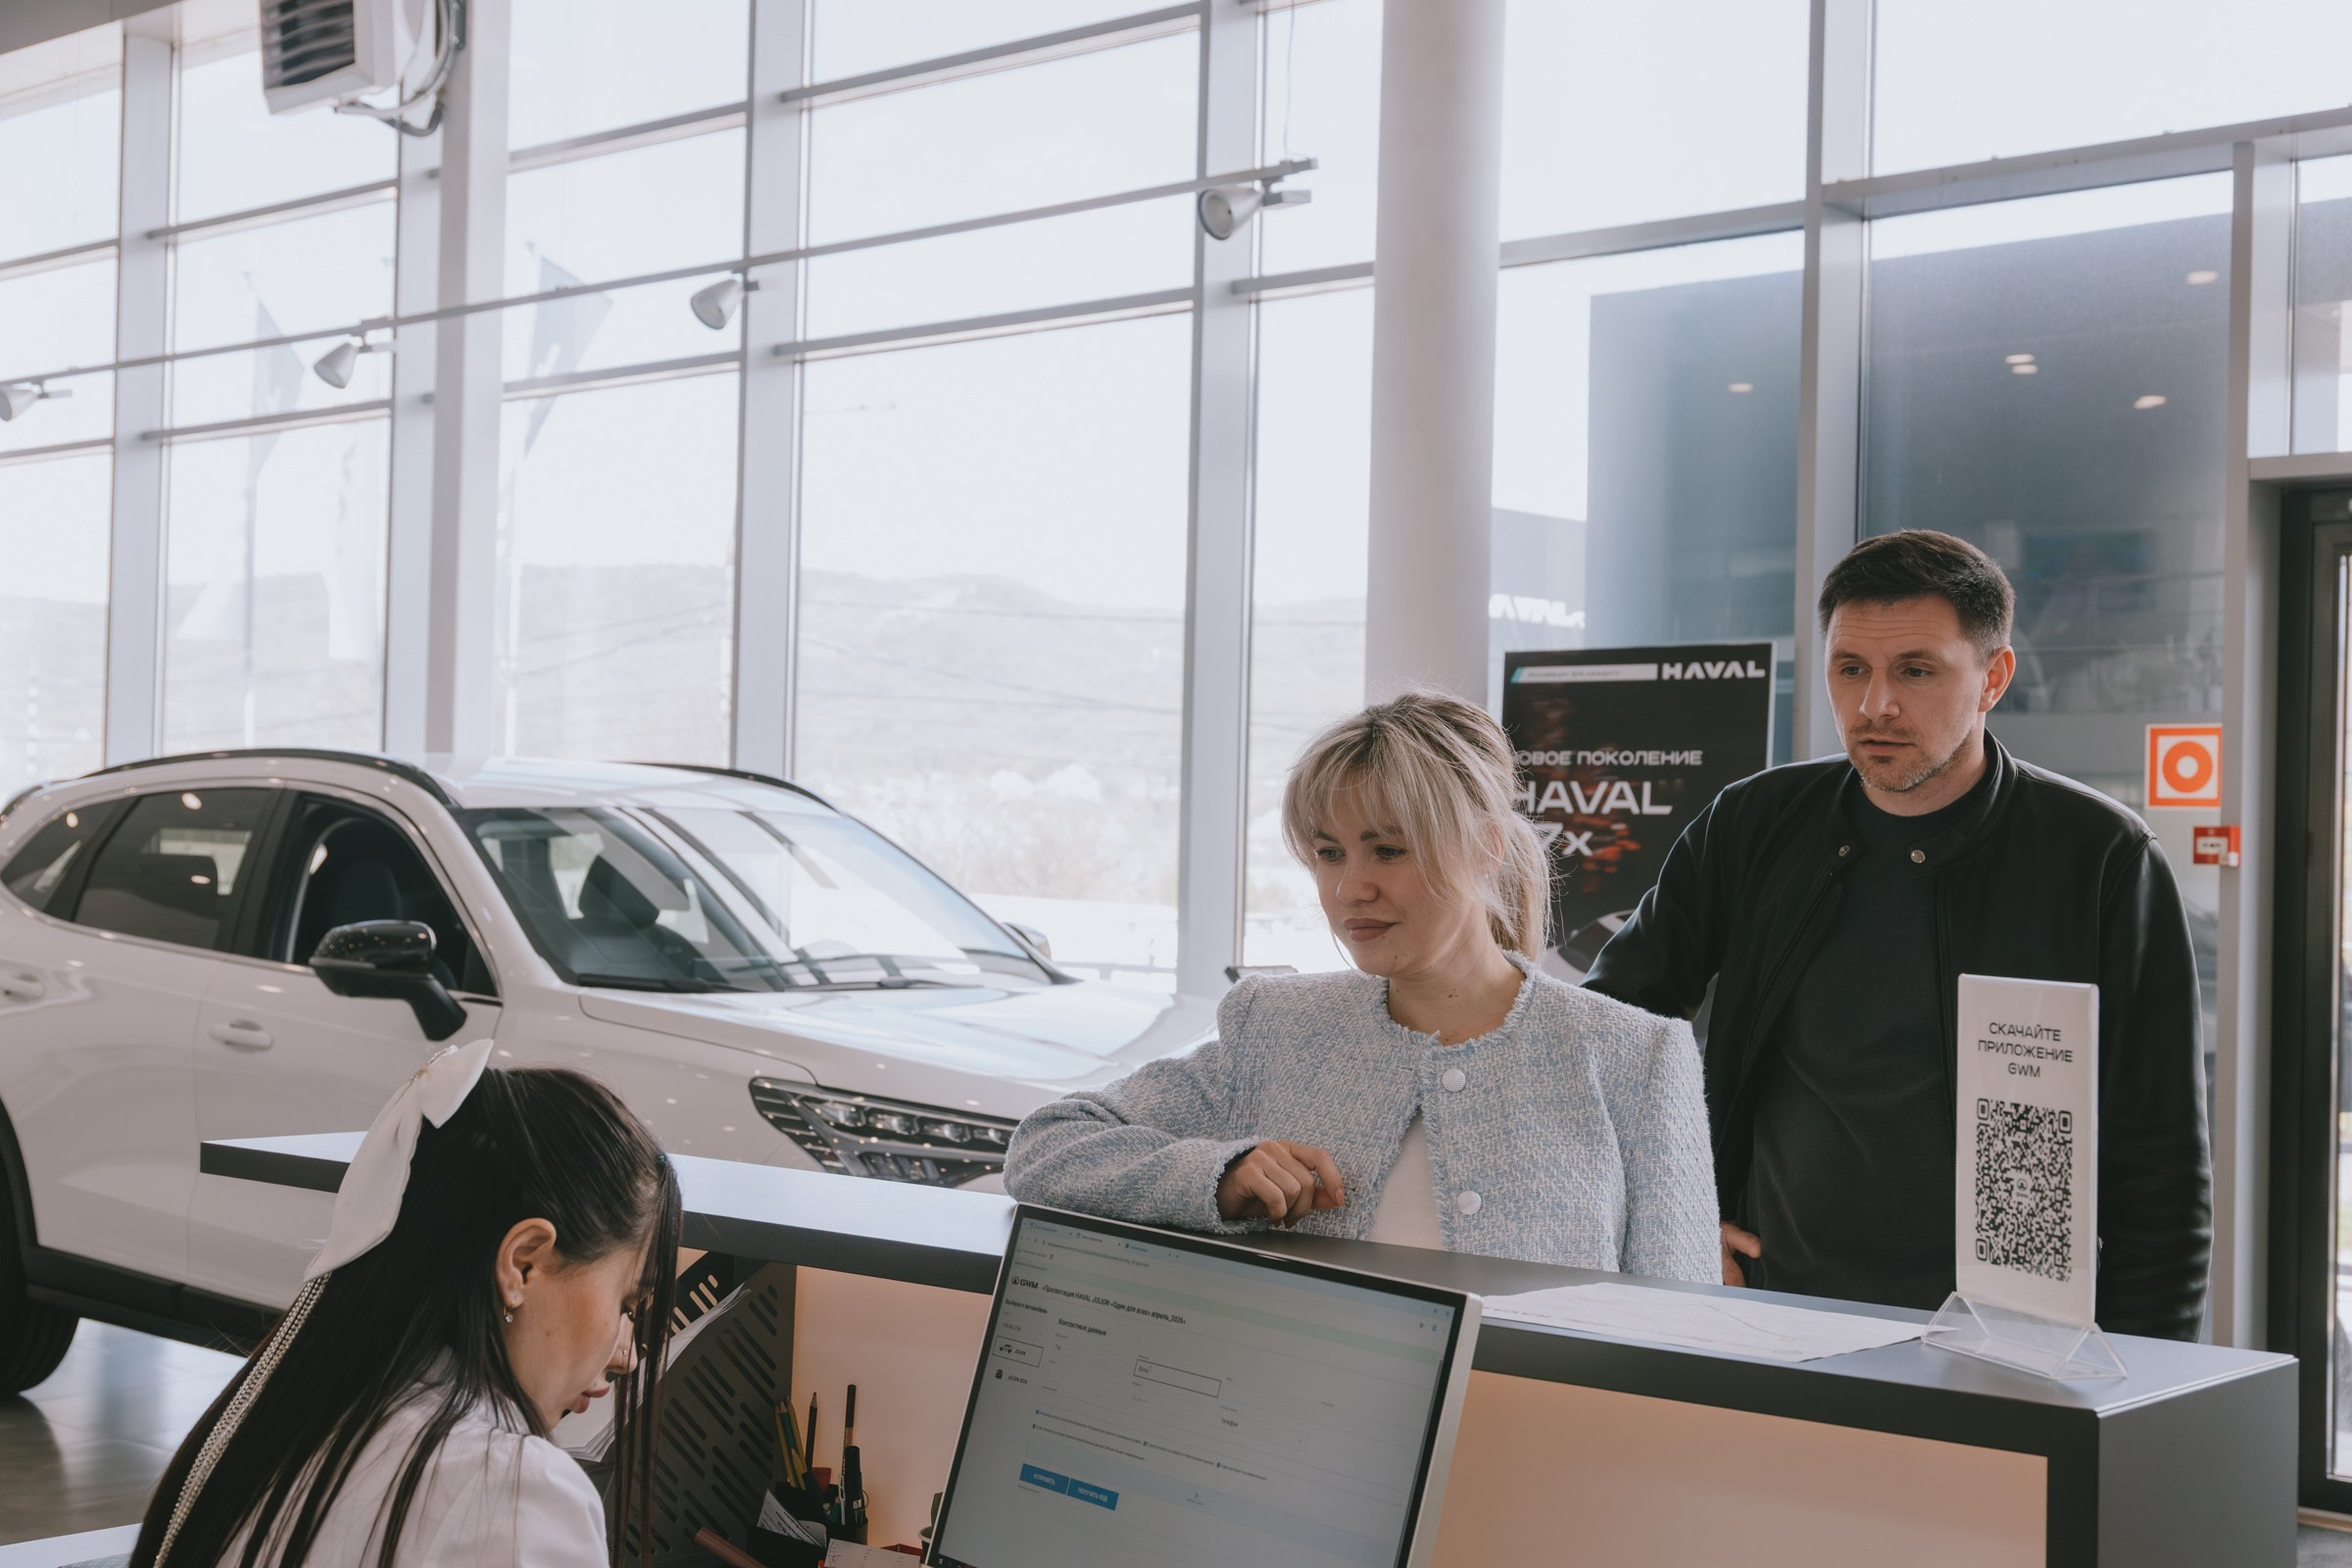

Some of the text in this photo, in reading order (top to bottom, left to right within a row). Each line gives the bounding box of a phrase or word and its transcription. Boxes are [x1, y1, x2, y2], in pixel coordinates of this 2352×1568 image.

[1661, 660, 1766, 680] HAVAL
[1516, 750, 1703, 766] ОВОЕ ПОКОЛЕНИЕ
[1515, 780, 1674, 815] HAVAL
[1988, 1021, 2062, 1042] СКАЧАЙТЕ
[1978, 1039, 2074, 1063] ПРИЛОЖЕНИЕ
[2007, 1061, 2041, 1078] GWM
[1019, 1277, 1039, 1291] GWM
[1075, 1291, 1092, 1302] HAVAL
